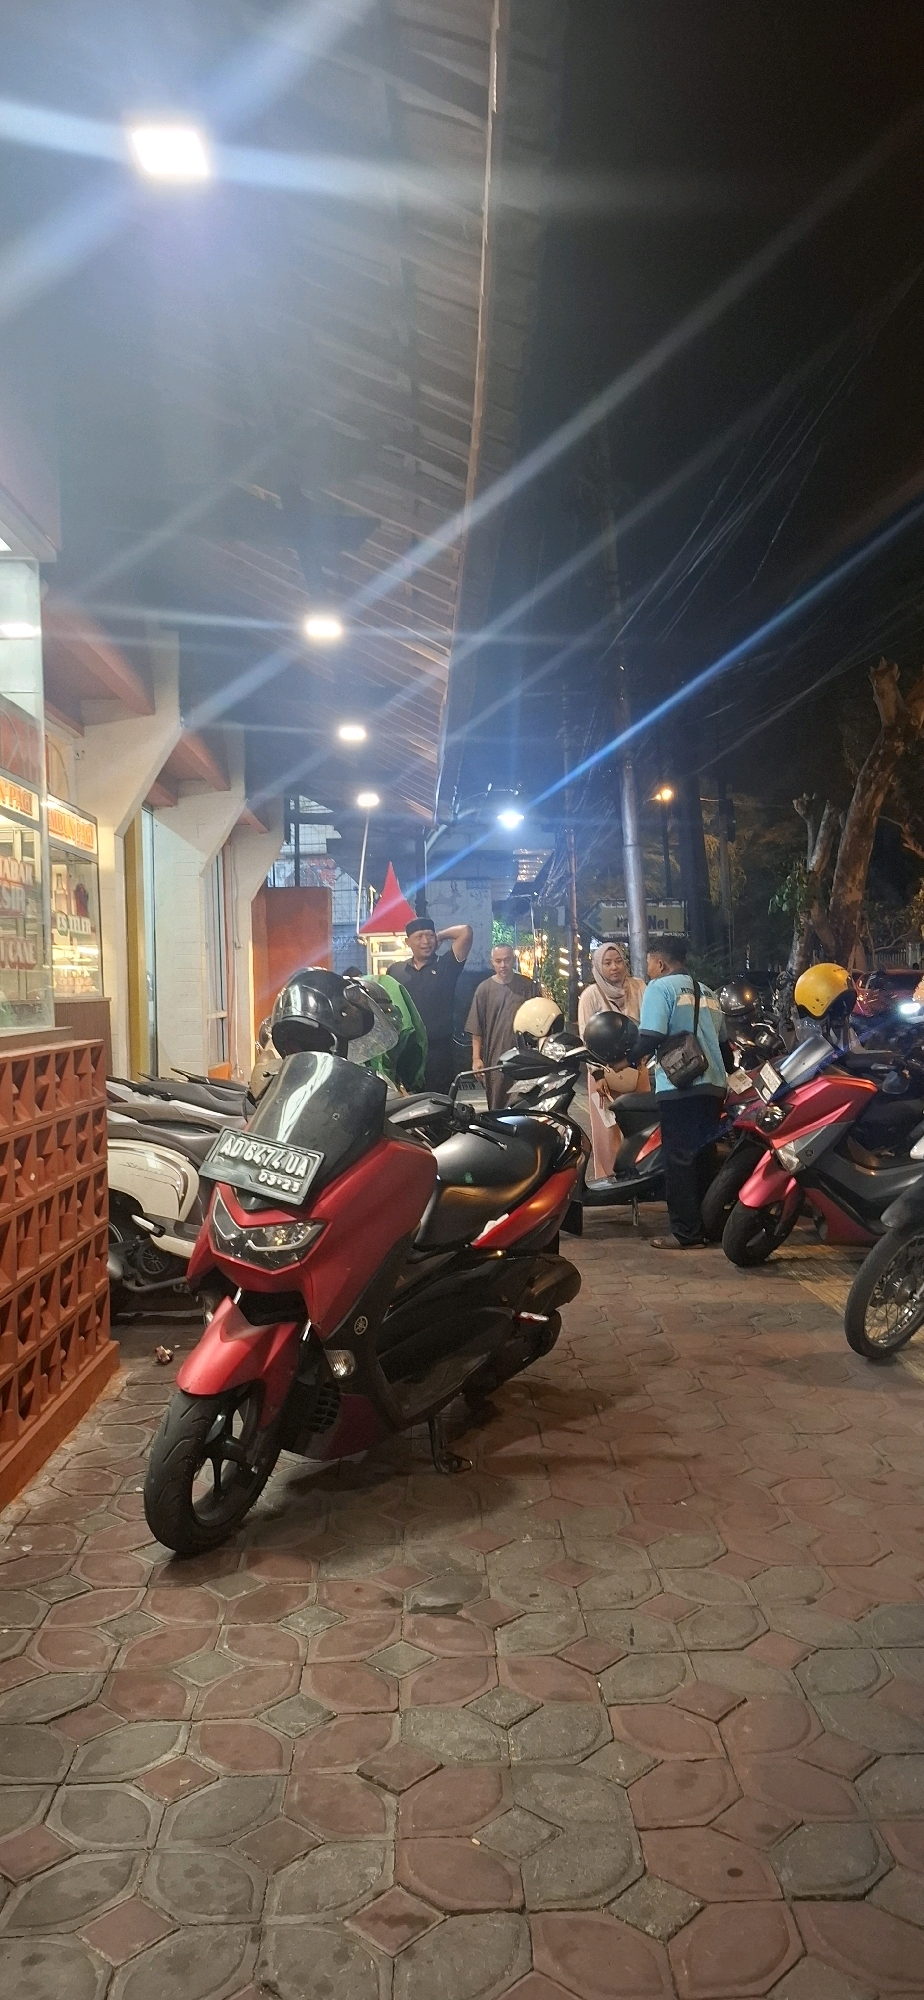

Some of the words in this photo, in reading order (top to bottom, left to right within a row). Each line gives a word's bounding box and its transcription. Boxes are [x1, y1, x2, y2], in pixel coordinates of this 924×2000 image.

[9, 784, 33, 816] PAGI
[77, 822, 94, 849] PAGI
[56, 912, 68, 933] ES
[68, 914, 92, 936] TELER
[219, 1136, 246, 1158] AD
[243, 1142, 287, 1170] 6474
[284, 1152, 310, 1178] UA
